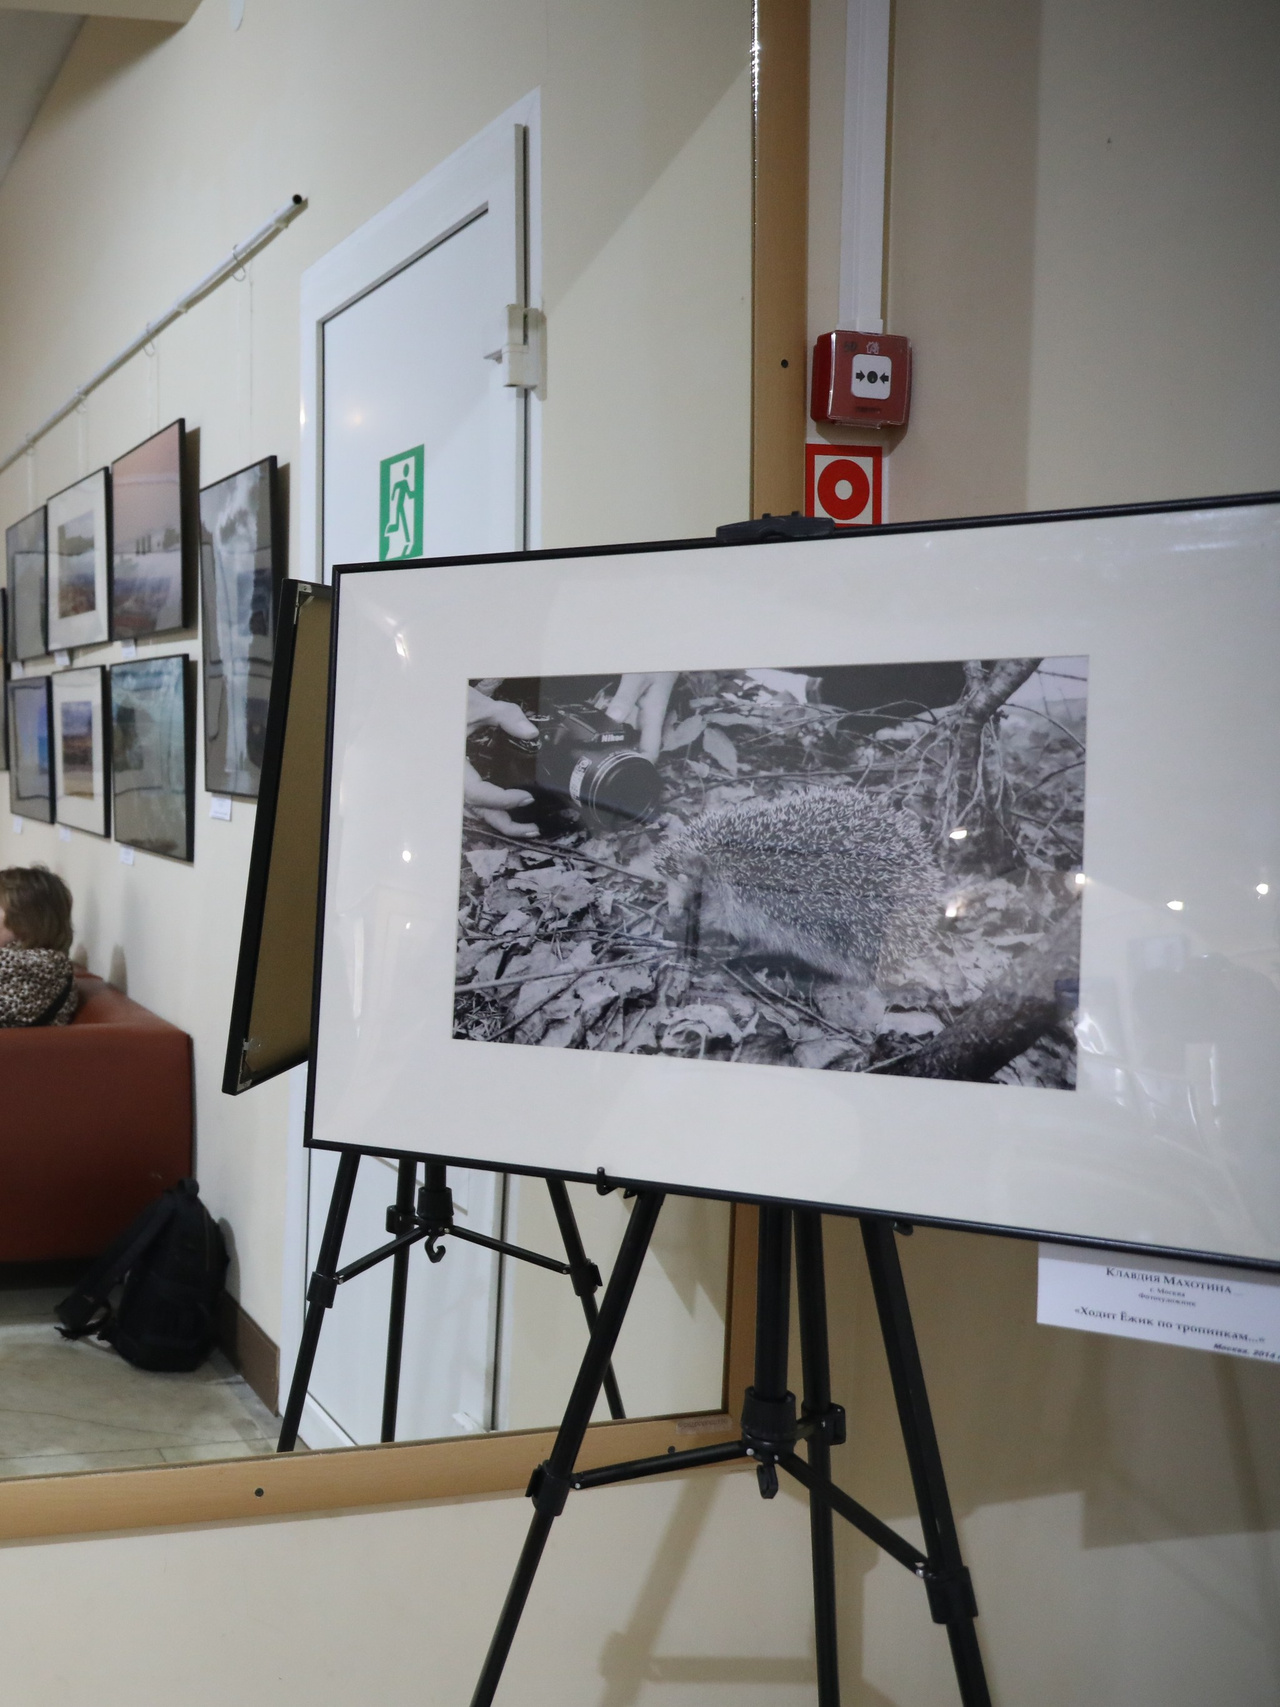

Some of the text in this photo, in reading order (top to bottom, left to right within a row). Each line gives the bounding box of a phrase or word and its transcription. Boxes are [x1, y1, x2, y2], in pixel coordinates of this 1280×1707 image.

[601, 734, 624, 742] Nikon
[1075, 1306, 1117, 1320] «Ходит
[1120, 1311, 1153, 1326] Ёжик
[1158, 1321, 1173, 1329] по
